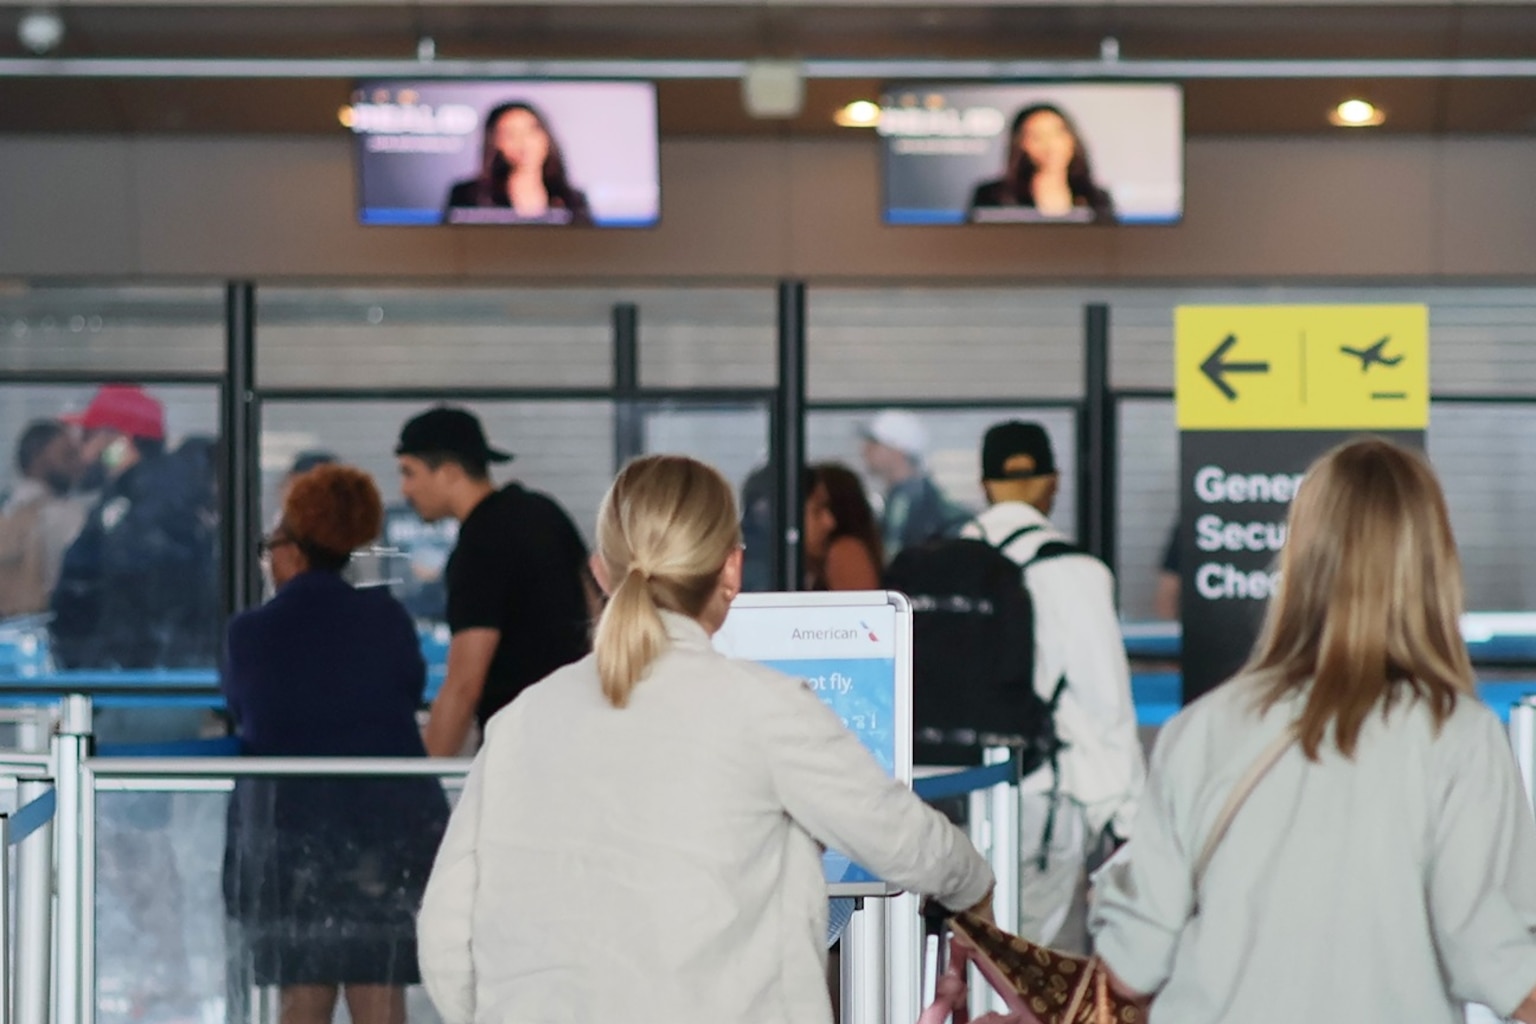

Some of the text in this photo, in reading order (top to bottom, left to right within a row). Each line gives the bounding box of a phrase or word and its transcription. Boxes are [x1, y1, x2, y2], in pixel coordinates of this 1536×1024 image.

[1195, 466, 1305, 501] Gener
[1196, 515, 1286, 550] Secu
[791, 627, 858, 640] American
[807, 675, 826, 690] ot
